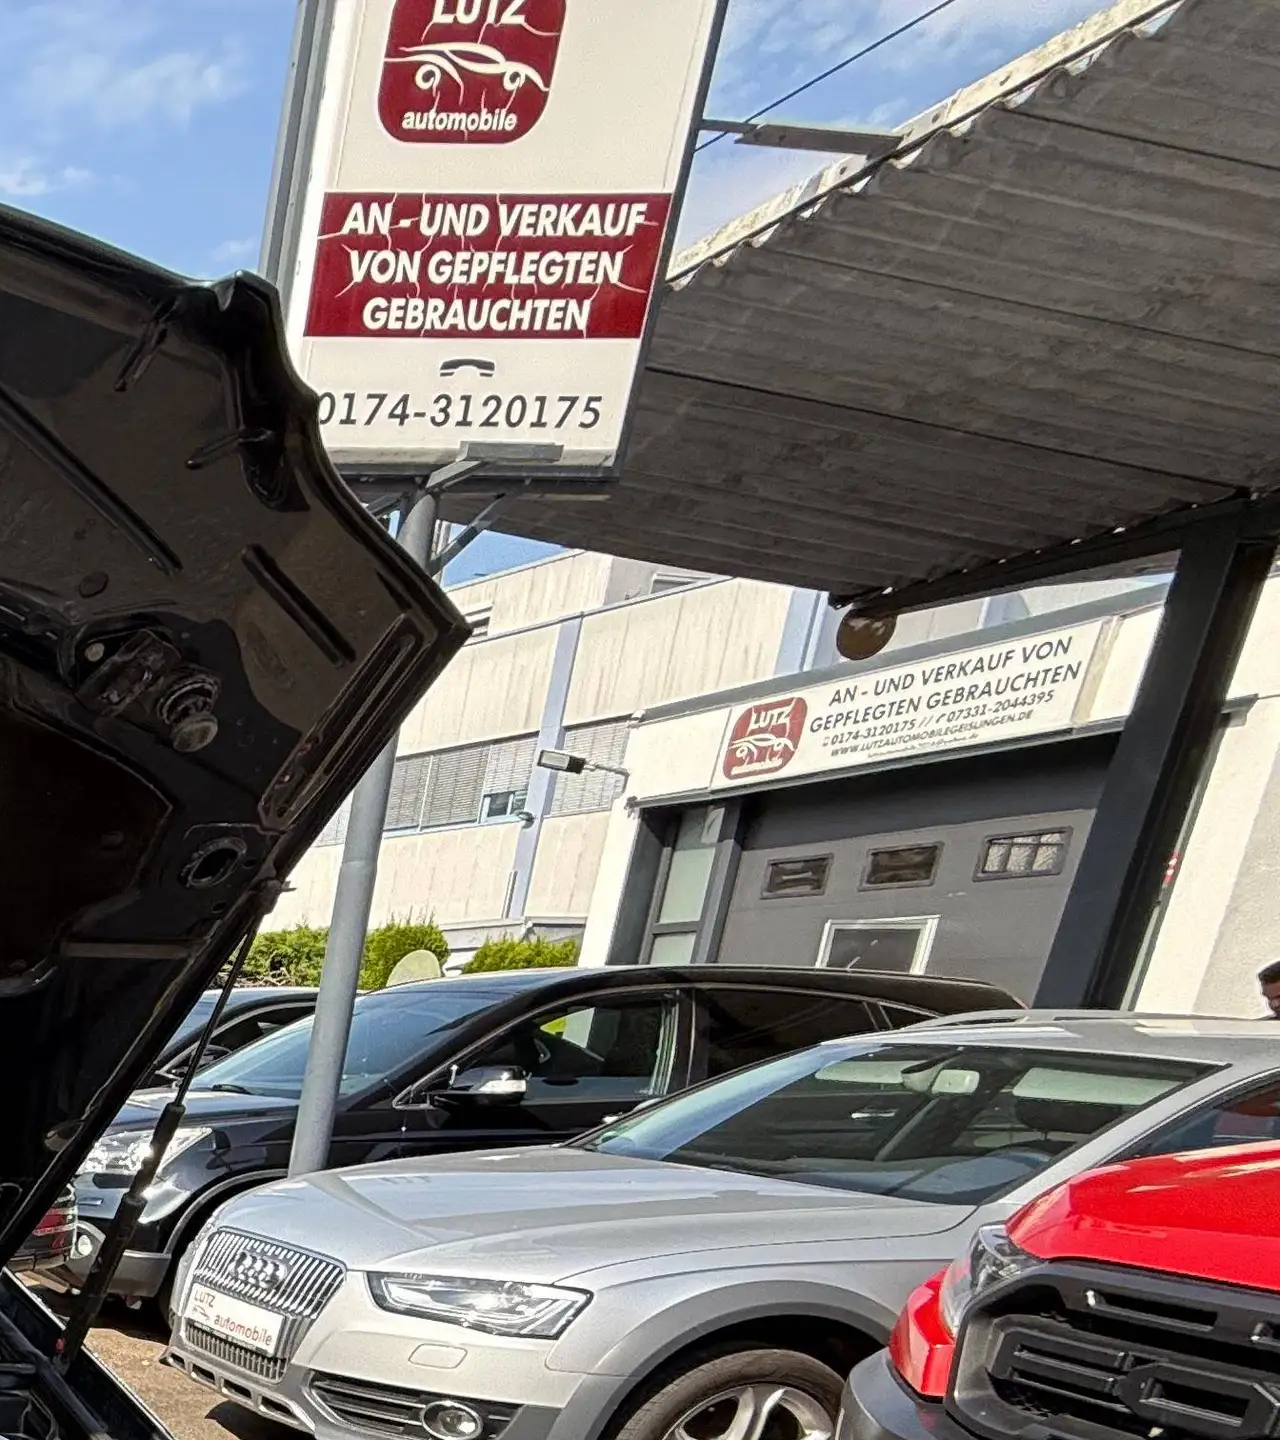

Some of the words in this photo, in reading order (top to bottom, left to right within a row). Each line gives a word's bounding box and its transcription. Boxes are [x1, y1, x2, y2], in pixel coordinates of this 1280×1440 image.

[401, 107, 518, 132] automobile
[341, 202, 392, 236] AN
[419, 202, 490, 236] UND
[498, 202, 648, 237] VERKAUF
[350, 250, 421, 285] VON
[428, 250, 625, 285] GEPFLEGTEN
[362, 298, 591, 331] GEBRAUCHTEN
[319, 392, 603, 430] 0174-3120175
[828, 685, 858, 707] AN
[873, 673, 915, 696] UND
[921, 649, 1016, 686] VERKAUF
[1021, 636, 1073, 664] VON
[809, 696, 922, 733] GEPFLEGTEN
[926, 661, 1082, 710] GEBRAUCHTEN
[749, 705, 792, 731] LUTZ
[831, 719, 917, 745] 0174-3120175
[946, 689, 1055, 724] 07331-2044395
[194, 1290, 216, 1308] LUTZ
[213, 1314, 273, 1346] automobile
